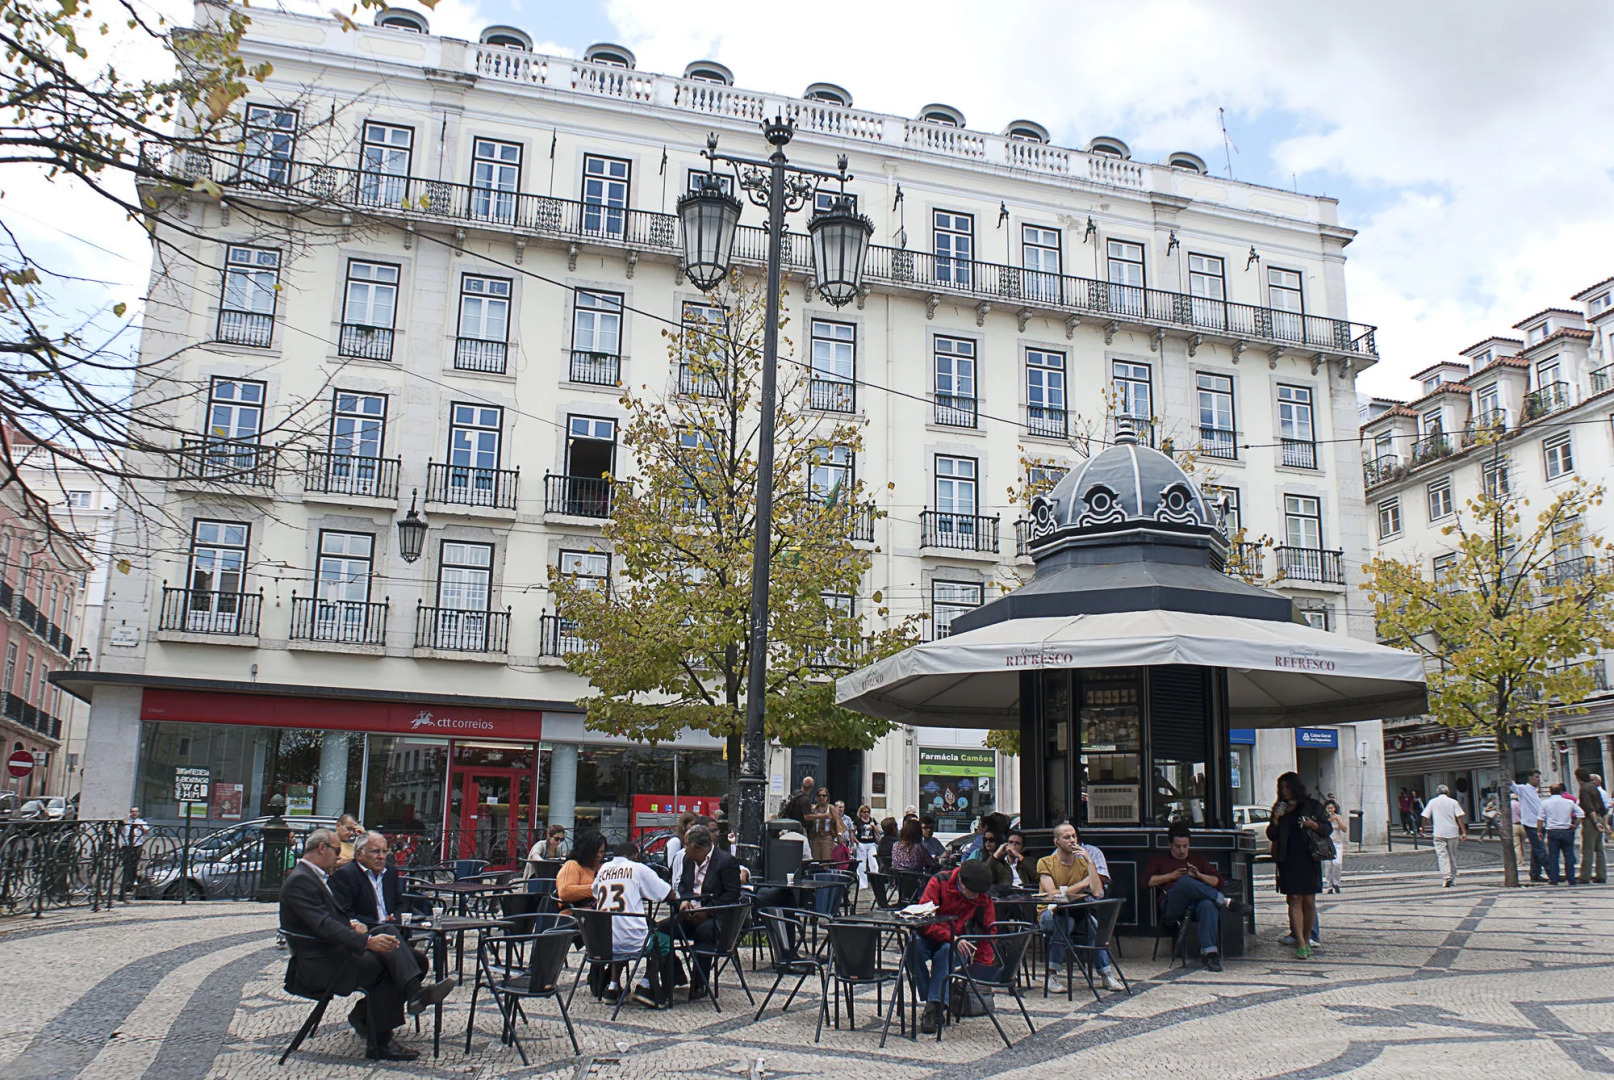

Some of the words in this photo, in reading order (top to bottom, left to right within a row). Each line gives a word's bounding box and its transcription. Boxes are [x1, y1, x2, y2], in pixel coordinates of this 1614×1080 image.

[1006, 653, 1073, 666] REFRESCO
[1275, 655, 1335, 671] REFRESCO
[437, 718, 451, 728] ctt
[452, 719, 494, 730] correios
[920, 752, 959, 761] Farmácia
[960, 754, 993, 762] Camões
